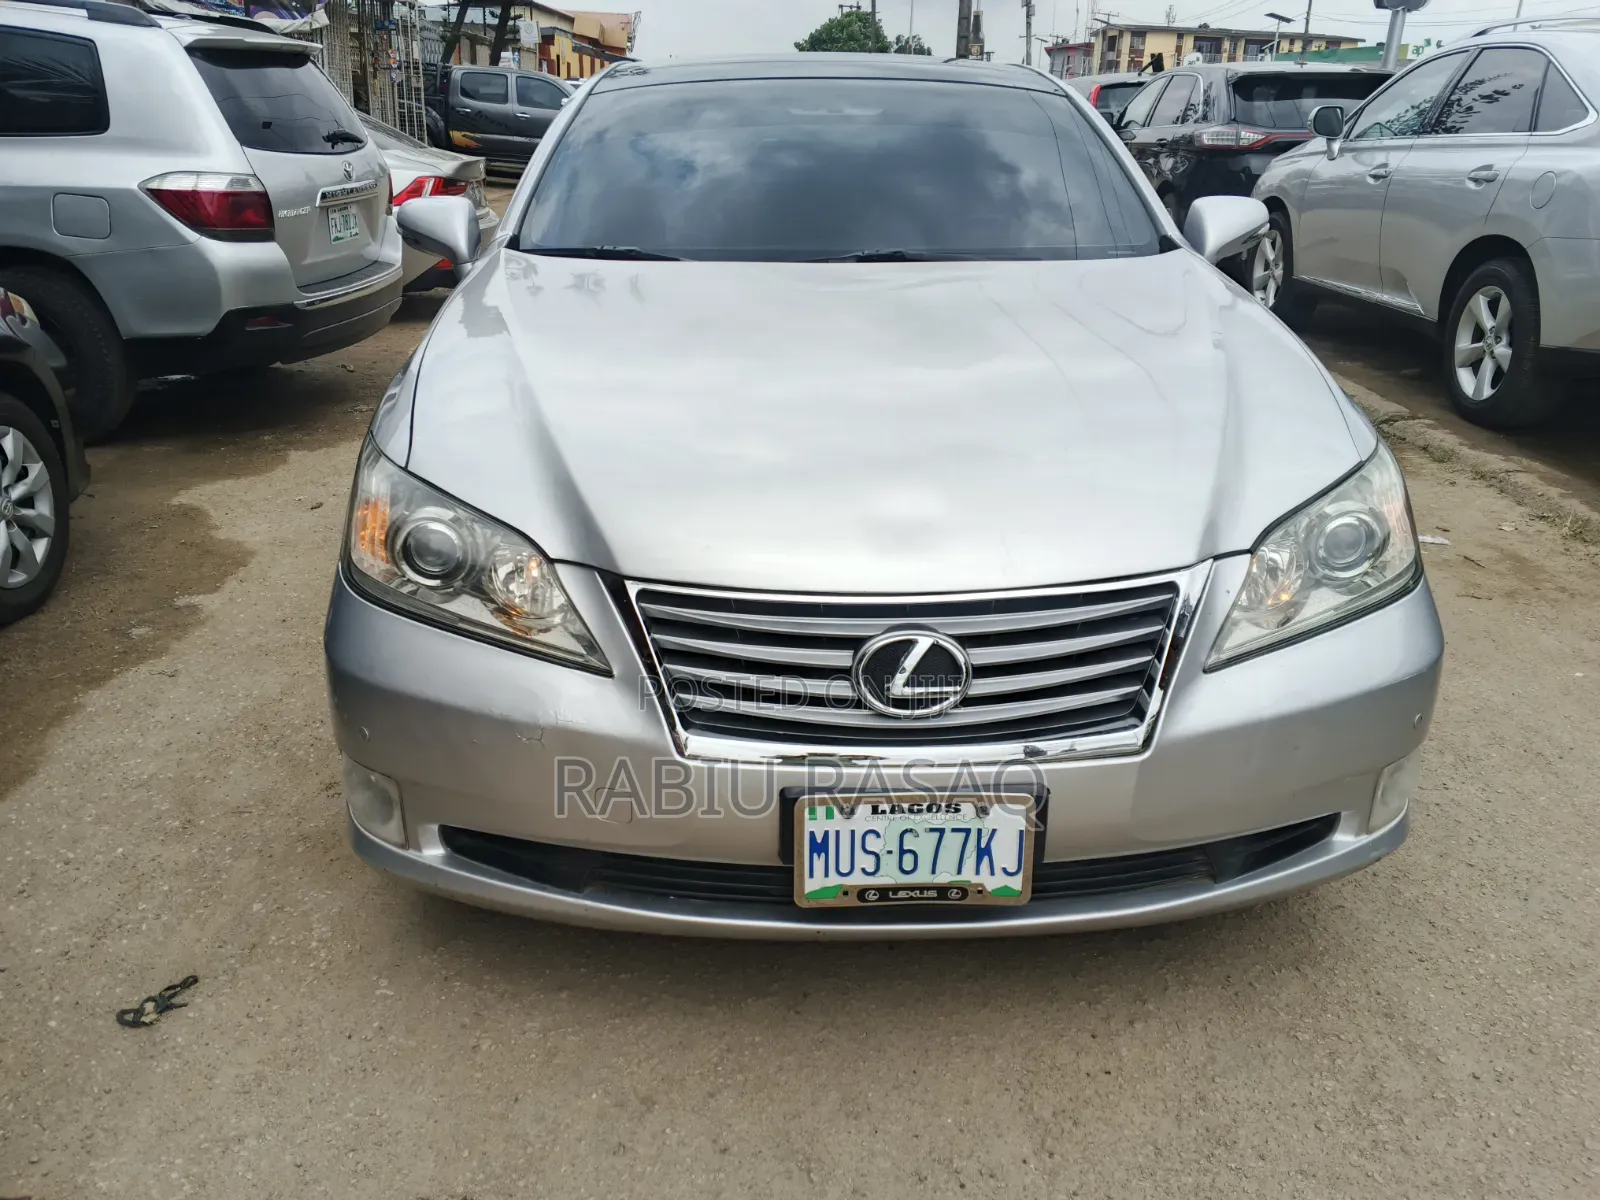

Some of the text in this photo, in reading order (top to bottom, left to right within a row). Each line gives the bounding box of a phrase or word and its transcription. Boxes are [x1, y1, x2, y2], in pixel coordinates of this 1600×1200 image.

[870, 803, 962, 816] LAGOS
[864, 815, 896, 823] CENTRE
[807, 827, 1025, 879] MUS-677KJ
[888, 890, 938, 898] LEXUS
